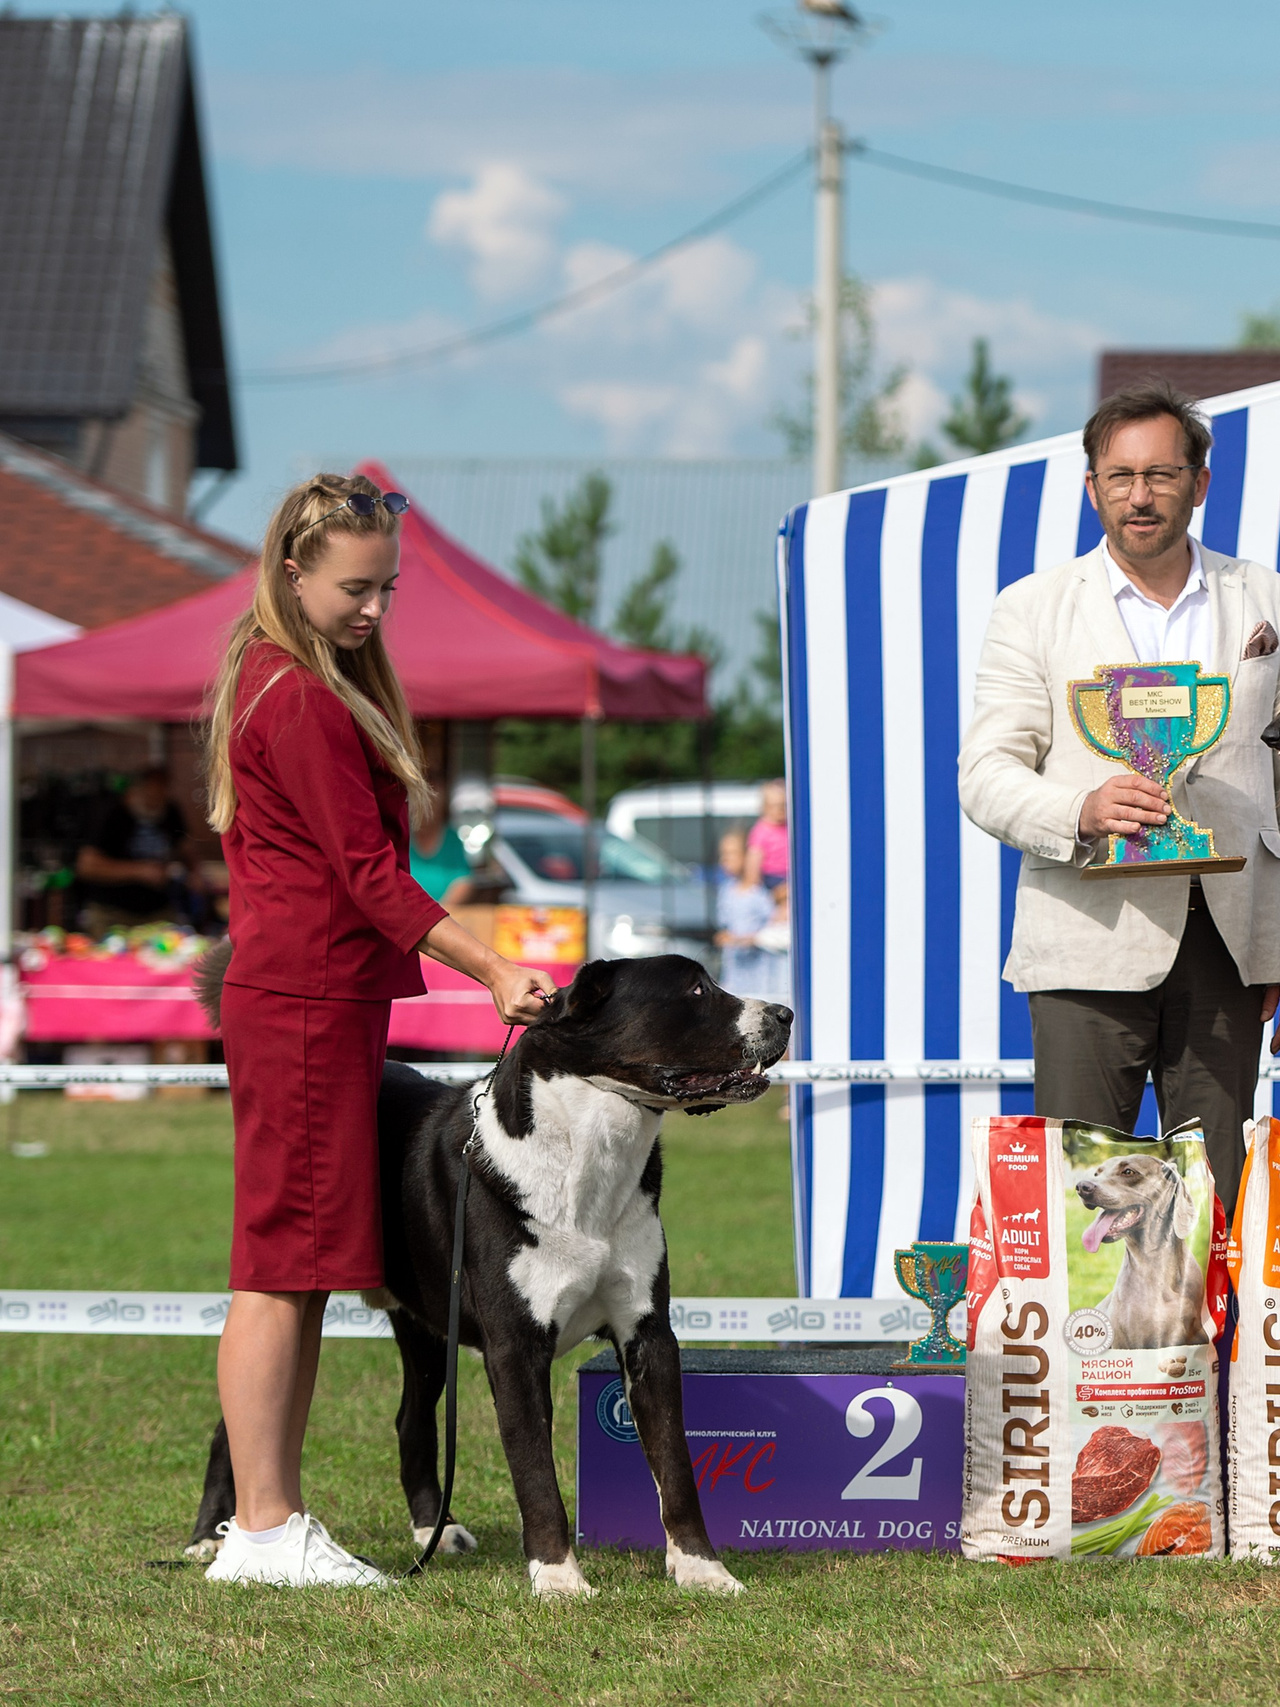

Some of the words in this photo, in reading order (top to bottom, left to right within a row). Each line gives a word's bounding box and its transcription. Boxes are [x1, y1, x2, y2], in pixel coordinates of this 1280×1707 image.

[1158, 698, 1182, 706] SHOW
[1145, 706, 1167, 714] Минск
[997, 1155, 1039, 1163] PREMIUM
[1001, 1229, 1041, 1246] ADULT
[971, 1248, 992, 1261] FOOD
[1001, 1255, 1014, 1263] ДЛЯ
[1014, 1256, 1042, 1264] ВЗРОСЛЫХ
[1013, 1263, 1031, 1271] СОБАК
[1074, 1325, 1106, 1340] 40%
[1081, 1358, 1133, 1369] МЯСНОЙ
[1082, 1370, 1132, 1380] РАЦИОН
[1188, 1369, 1195, 1377] 15
[1094, 1388, 1126, 1396] Комплекс
[1126, 1387, 1167, 1397] пробиотиков
[1169, 1385, 1203, 1396] ProStor+
[1001, 1301, 1050, 1529] SIRIUS
[685, 1430, 755, 1438] КИНОЛОГИЧЕСКИЙ
[841, 1387, 923, 1501] 2
[739, 1520, 866, 1538] NATIONAL
[877, 1521, 933, 1539] DOG
[1001, 1535, 1050, 1547] PREMIUM
